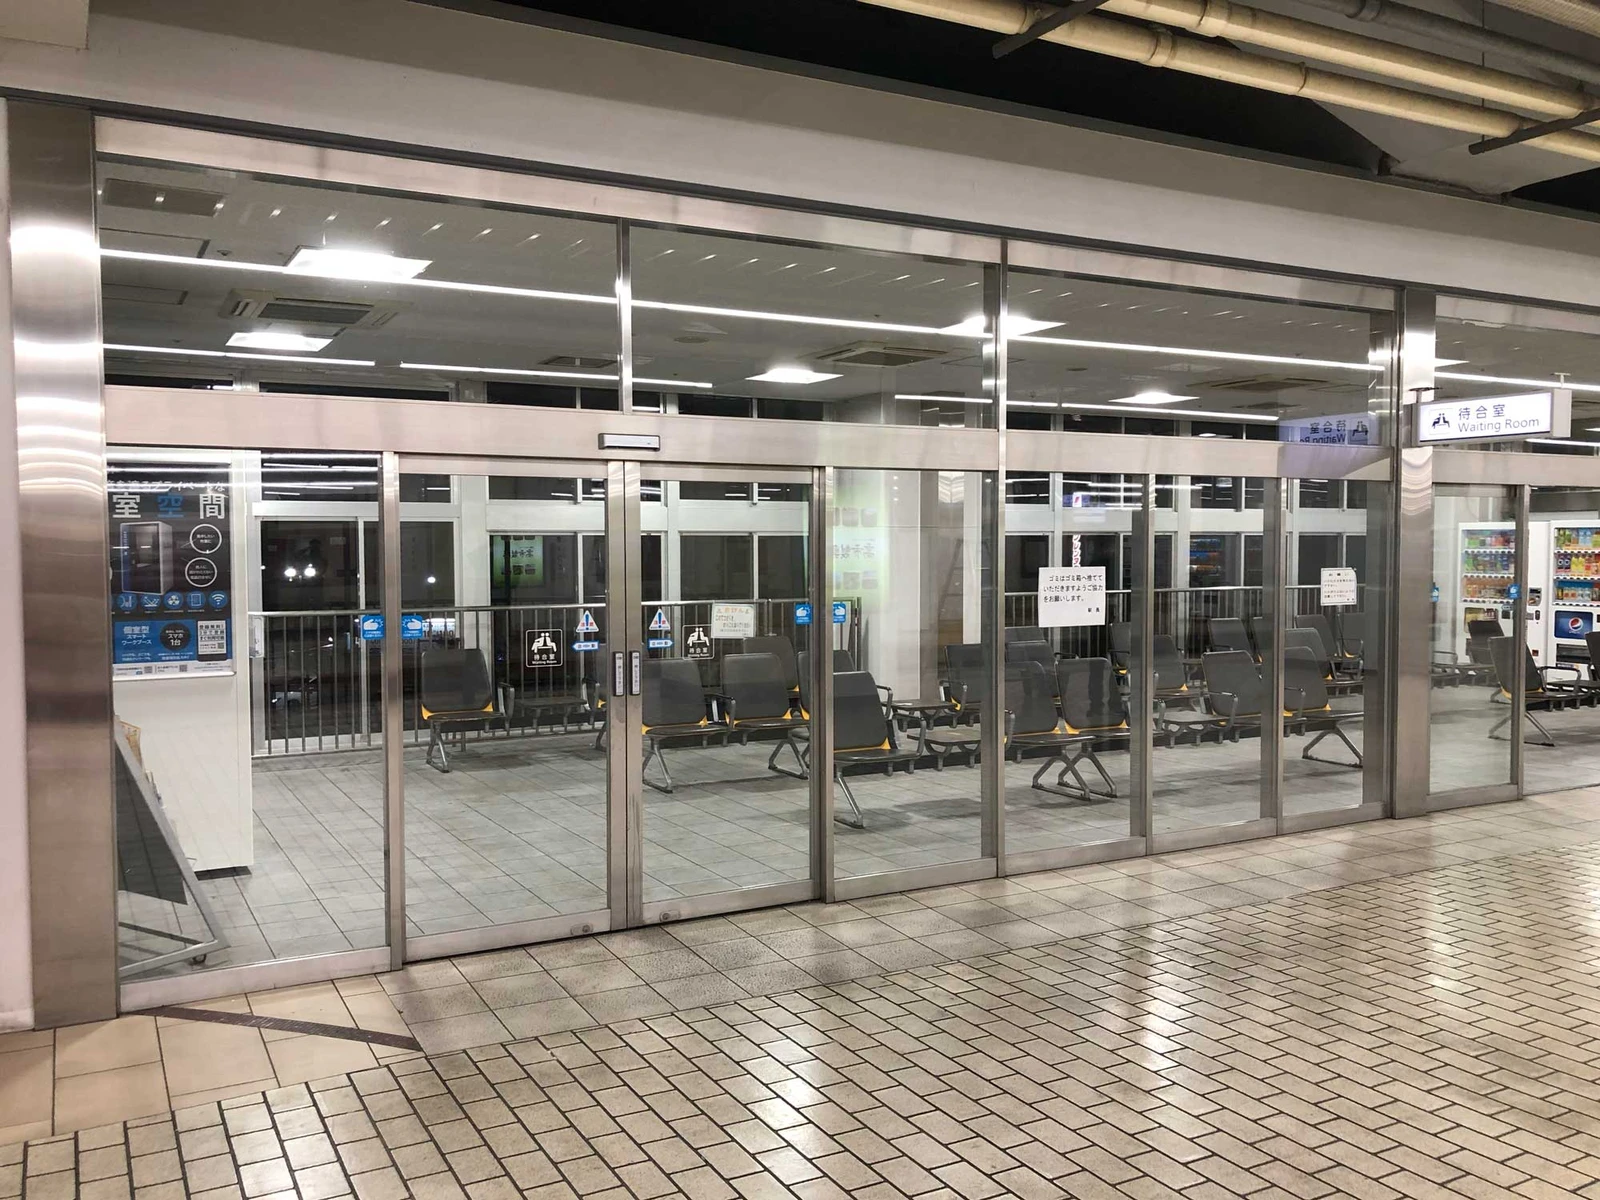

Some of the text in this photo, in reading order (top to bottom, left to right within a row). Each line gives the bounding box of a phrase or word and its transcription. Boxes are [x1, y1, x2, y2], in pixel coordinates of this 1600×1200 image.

[1458, 404, 1506, 420] 待合室
[1458, 417, 1540, 433] Waiting Room
[1049, 574, 1103, 582] ゴミはゴミ箱へ捨てて
[1043, 584, 1103, 592] いただきますようご協力
[1043, 595, 1084, 603] をお願いします。
